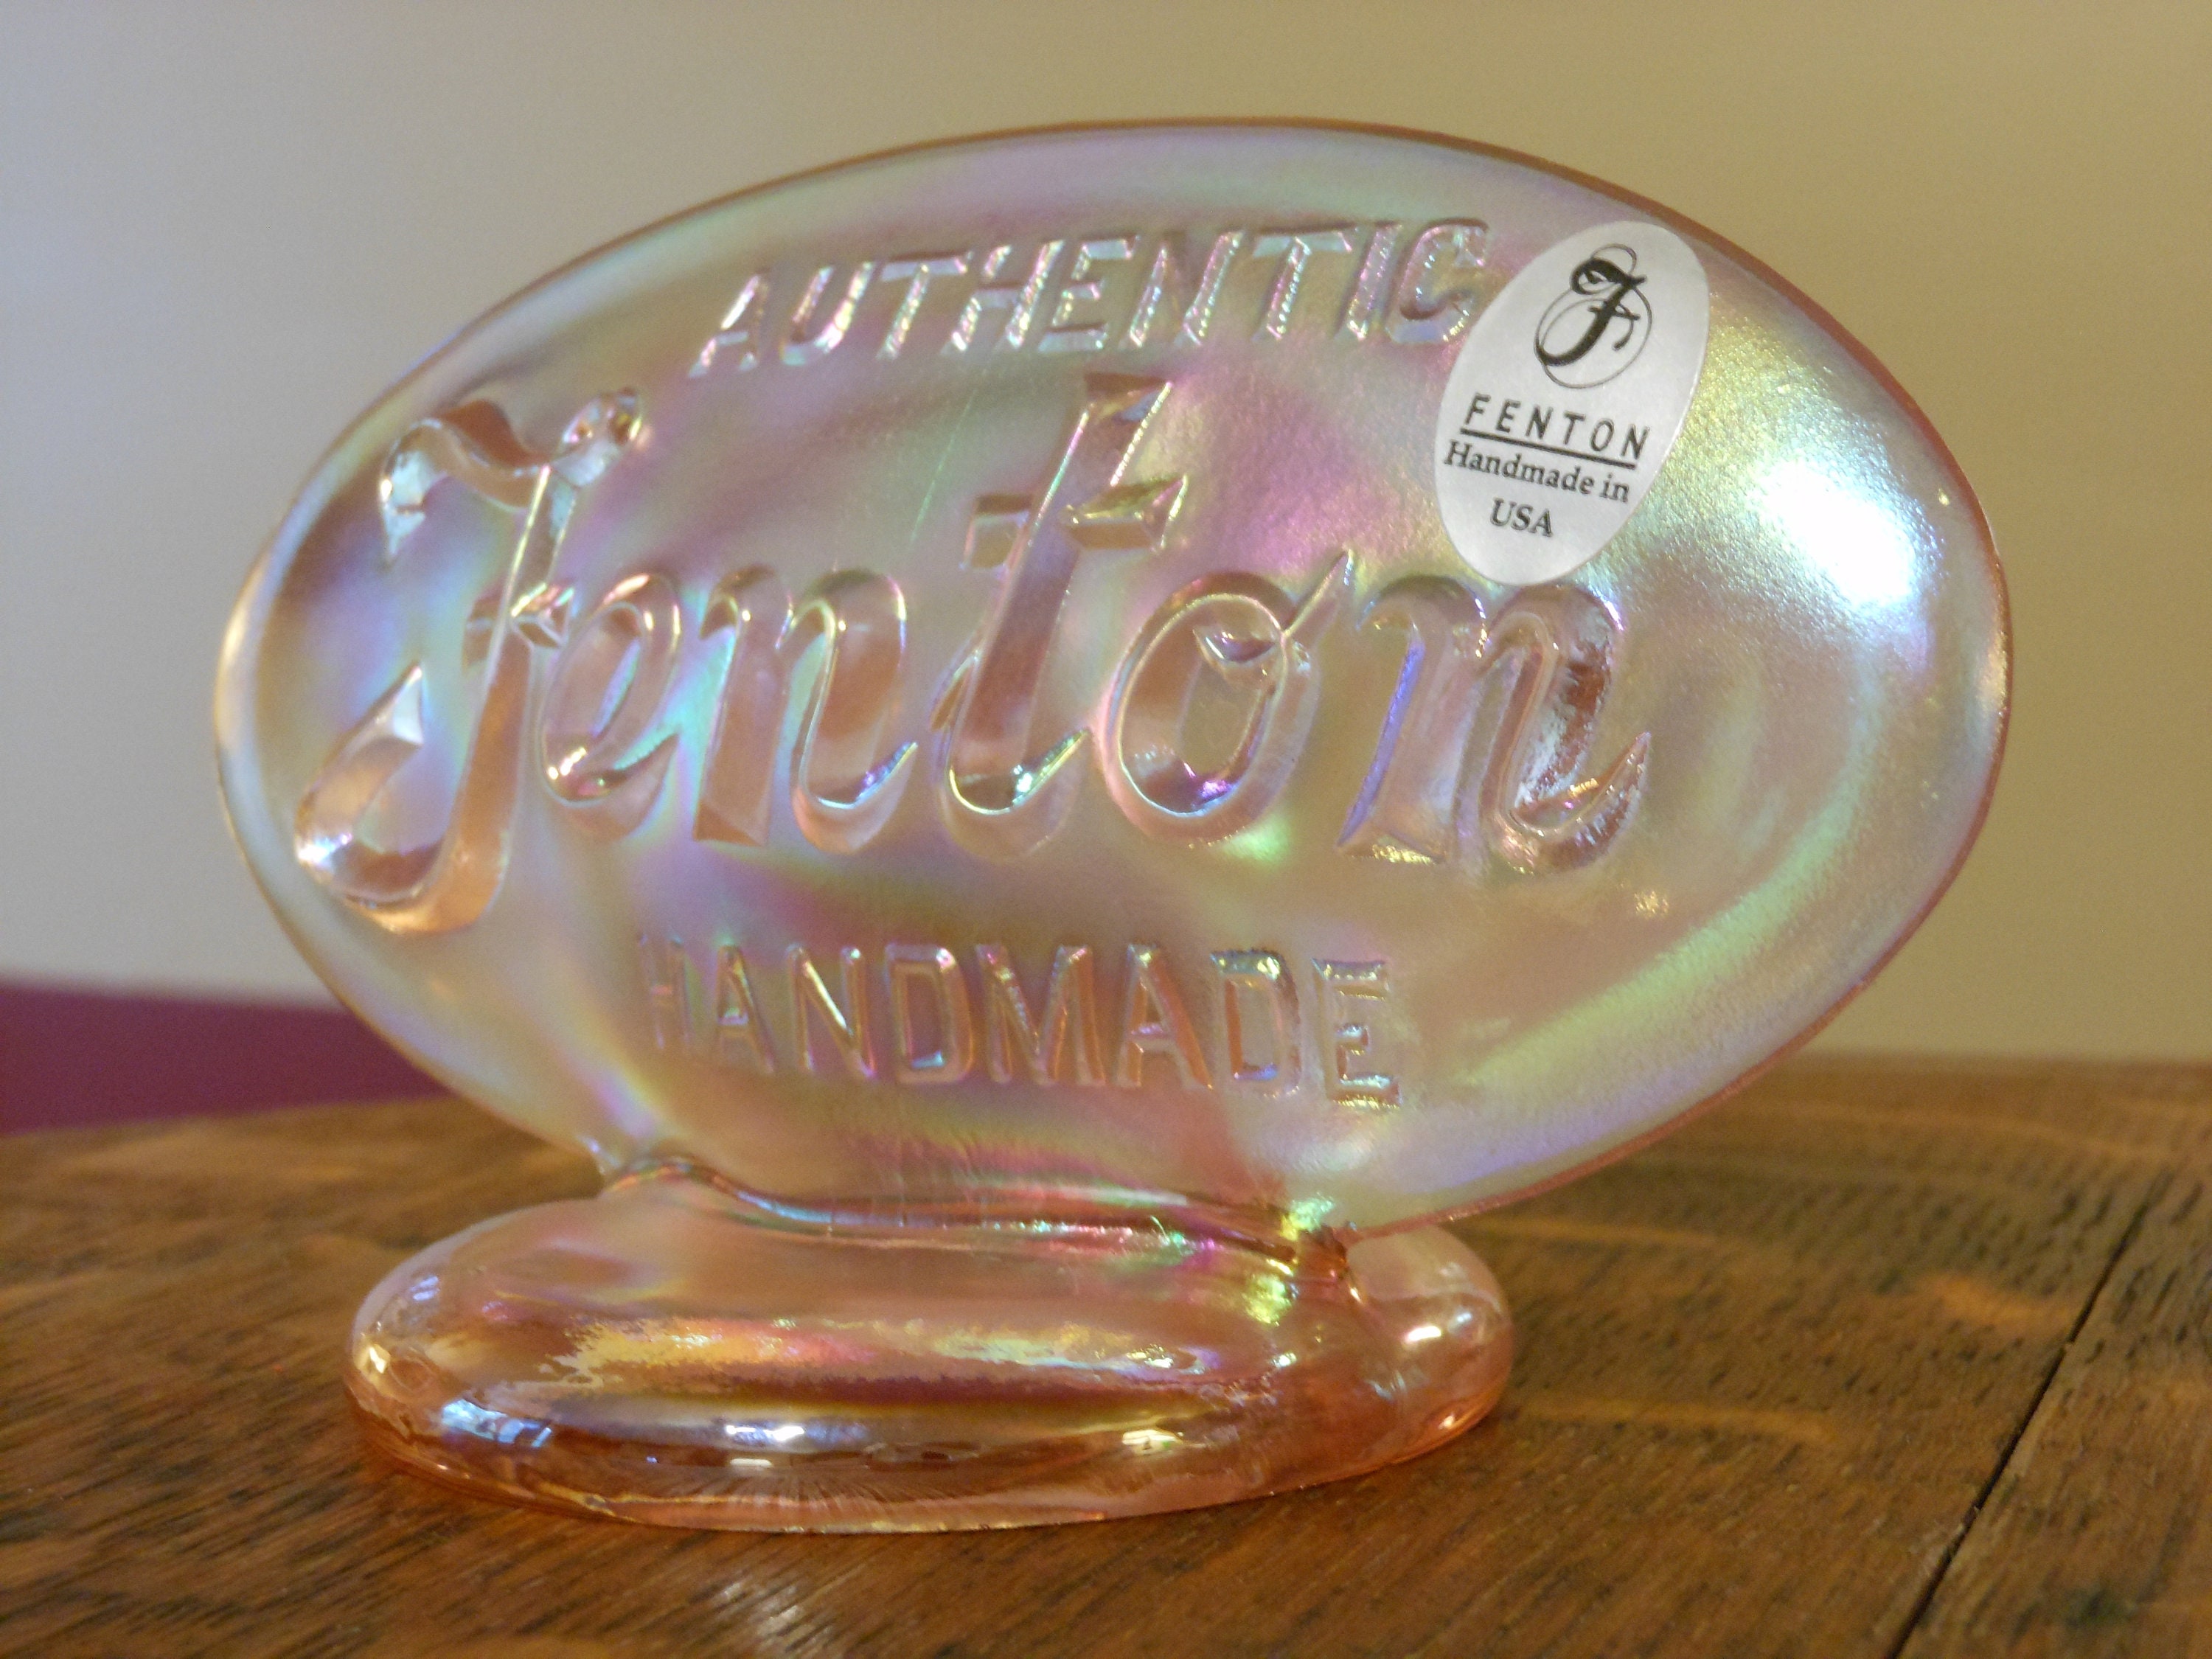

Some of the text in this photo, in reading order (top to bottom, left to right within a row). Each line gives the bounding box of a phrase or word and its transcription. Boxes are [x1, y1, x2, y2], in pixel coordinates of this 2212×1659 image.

[687, 217, 1491, 378] AUTHENTIC
[1442, 439, 1630, 503] Handmade in
[1463, 393, 1651, 462] FENTON
[1489, 498, 1554, 538] USA
[293, 375, 1652, 936] Fenton
[639, 933, 1402, 1109] HANDMADE
